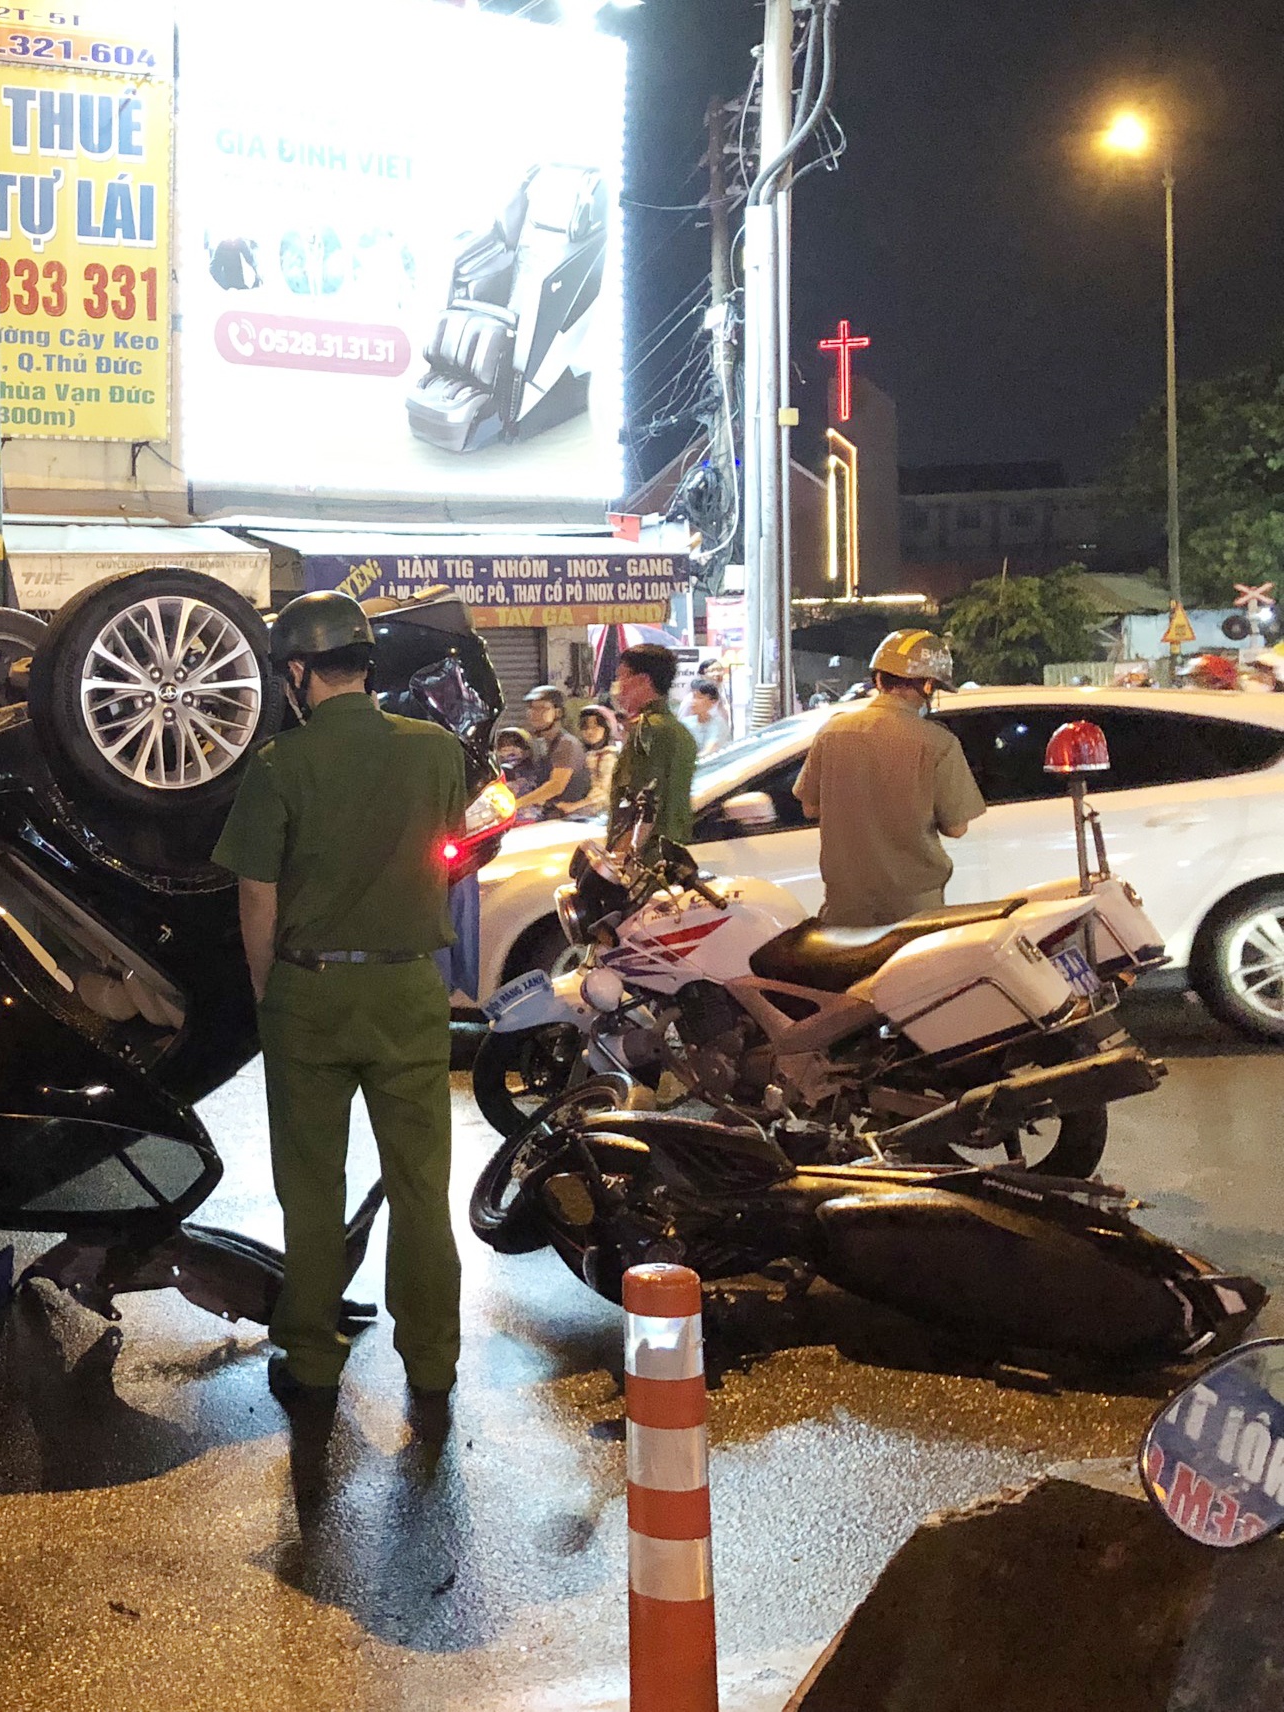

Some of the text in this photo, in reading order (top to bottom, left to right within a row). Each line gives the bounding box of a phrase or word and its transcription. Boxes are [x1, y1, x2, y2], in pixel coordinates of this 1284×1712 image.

[216, 128, 266, 160] GIA
[76, 173, 155, 242] LÁI
[83, 262, 158, 321] 331
[59, 328, 105, 350] Cây
[113, 331, 160, 350] Keo
[258, 327, 395, 363] 0528.31.31.31
[18, 351, 87, 374] Q.Thủ
[95, 355, 143, 376] Đức
[0, 381, 46, 401] hùa
[55, 383, 100, 406] Vạn
[108, 384, 156, 405] Đức
[444, 559, 474, 579] TIG
[493, 555, 548, 578] NHÔM
[567, 559, 610, 578] INOX
[626, 558, 674, 577] GANG
[455, 581, 486, 603] MÓC
[513, 583, 542, 603] THAY
[544, 577, 563, 603] CỔ
[566, 580, 583, 602] PÔ
[586, 582, 615, 601] INOX
[617, 580, 643, 601] CÁC
[541, 605, 574, 625] GA
[597, 603, 665, 624] HOND
